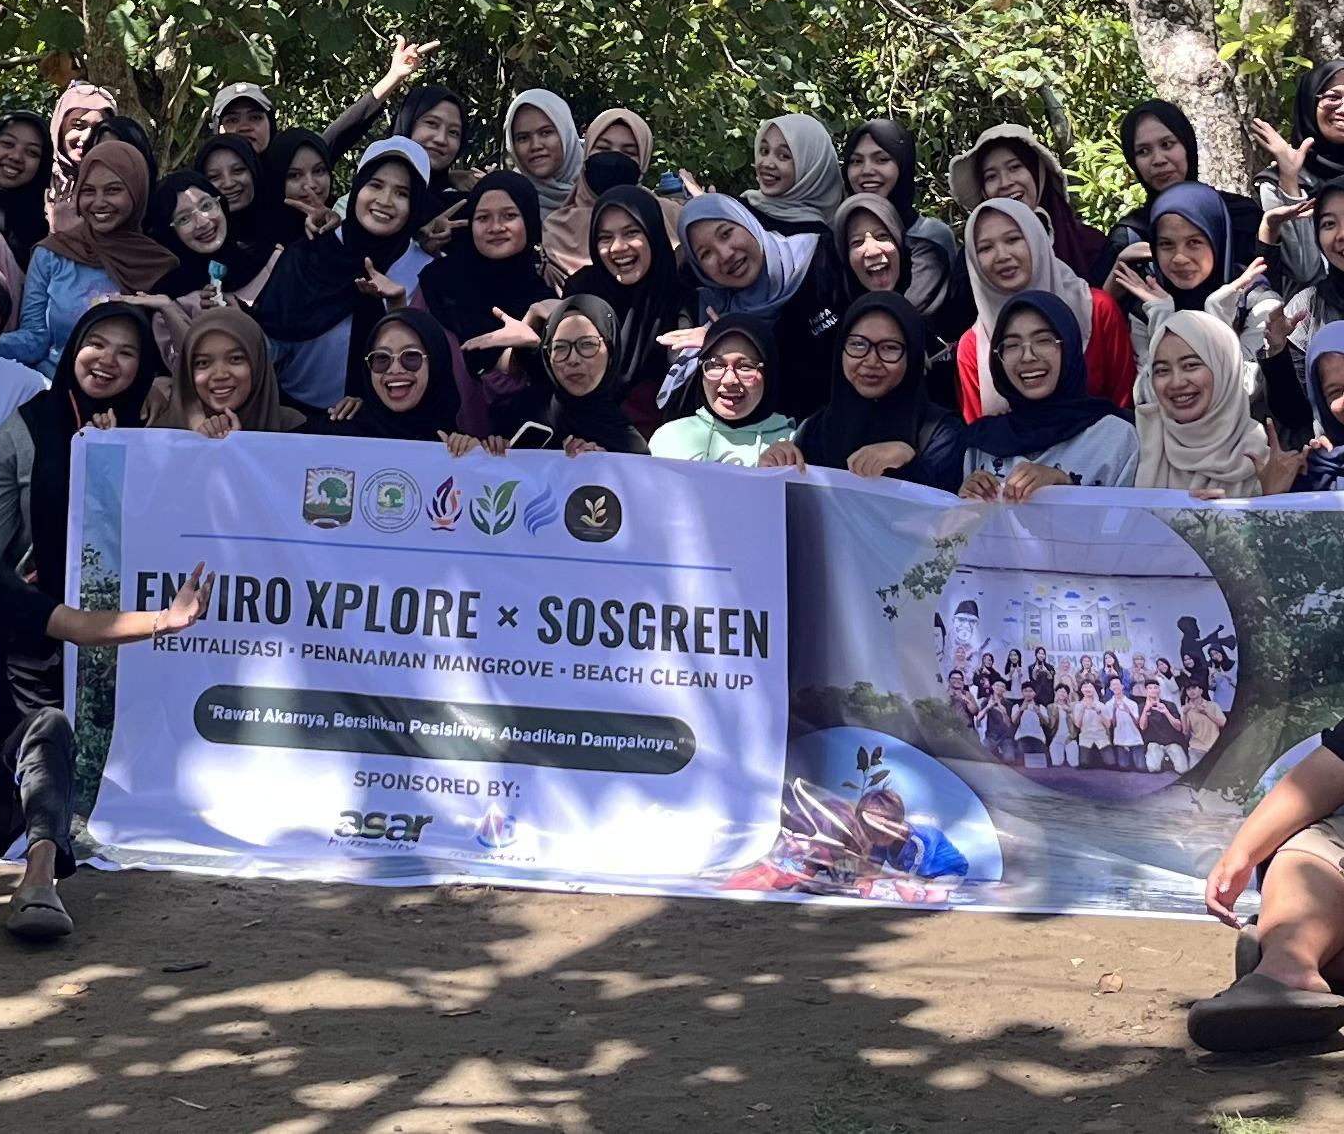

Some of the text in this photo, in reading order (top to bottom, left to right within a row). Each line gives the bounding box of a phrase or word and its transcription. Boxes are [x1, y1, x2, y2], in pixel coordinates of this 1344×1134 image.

[306, 579, 481, 639] XPLORE
[537, 595, 769, 659] SOSGREEN
[153, 635, 754, 691] REVITALISASI PENANAMAN MANGROVE BEACH CLEAN UP
[208, 704, 259, 722] "Rawat
[262, 707, 329, 729] Akarnya,
[333, 712, 405, 733] Bersihkan
[409, 718, 495, 741] Pesisirnya,
[499, 726, 576, 746] Abadikan
[353, 770, 521, 798] SPONSORED BY:
[334, 809, 434, 843] asar
